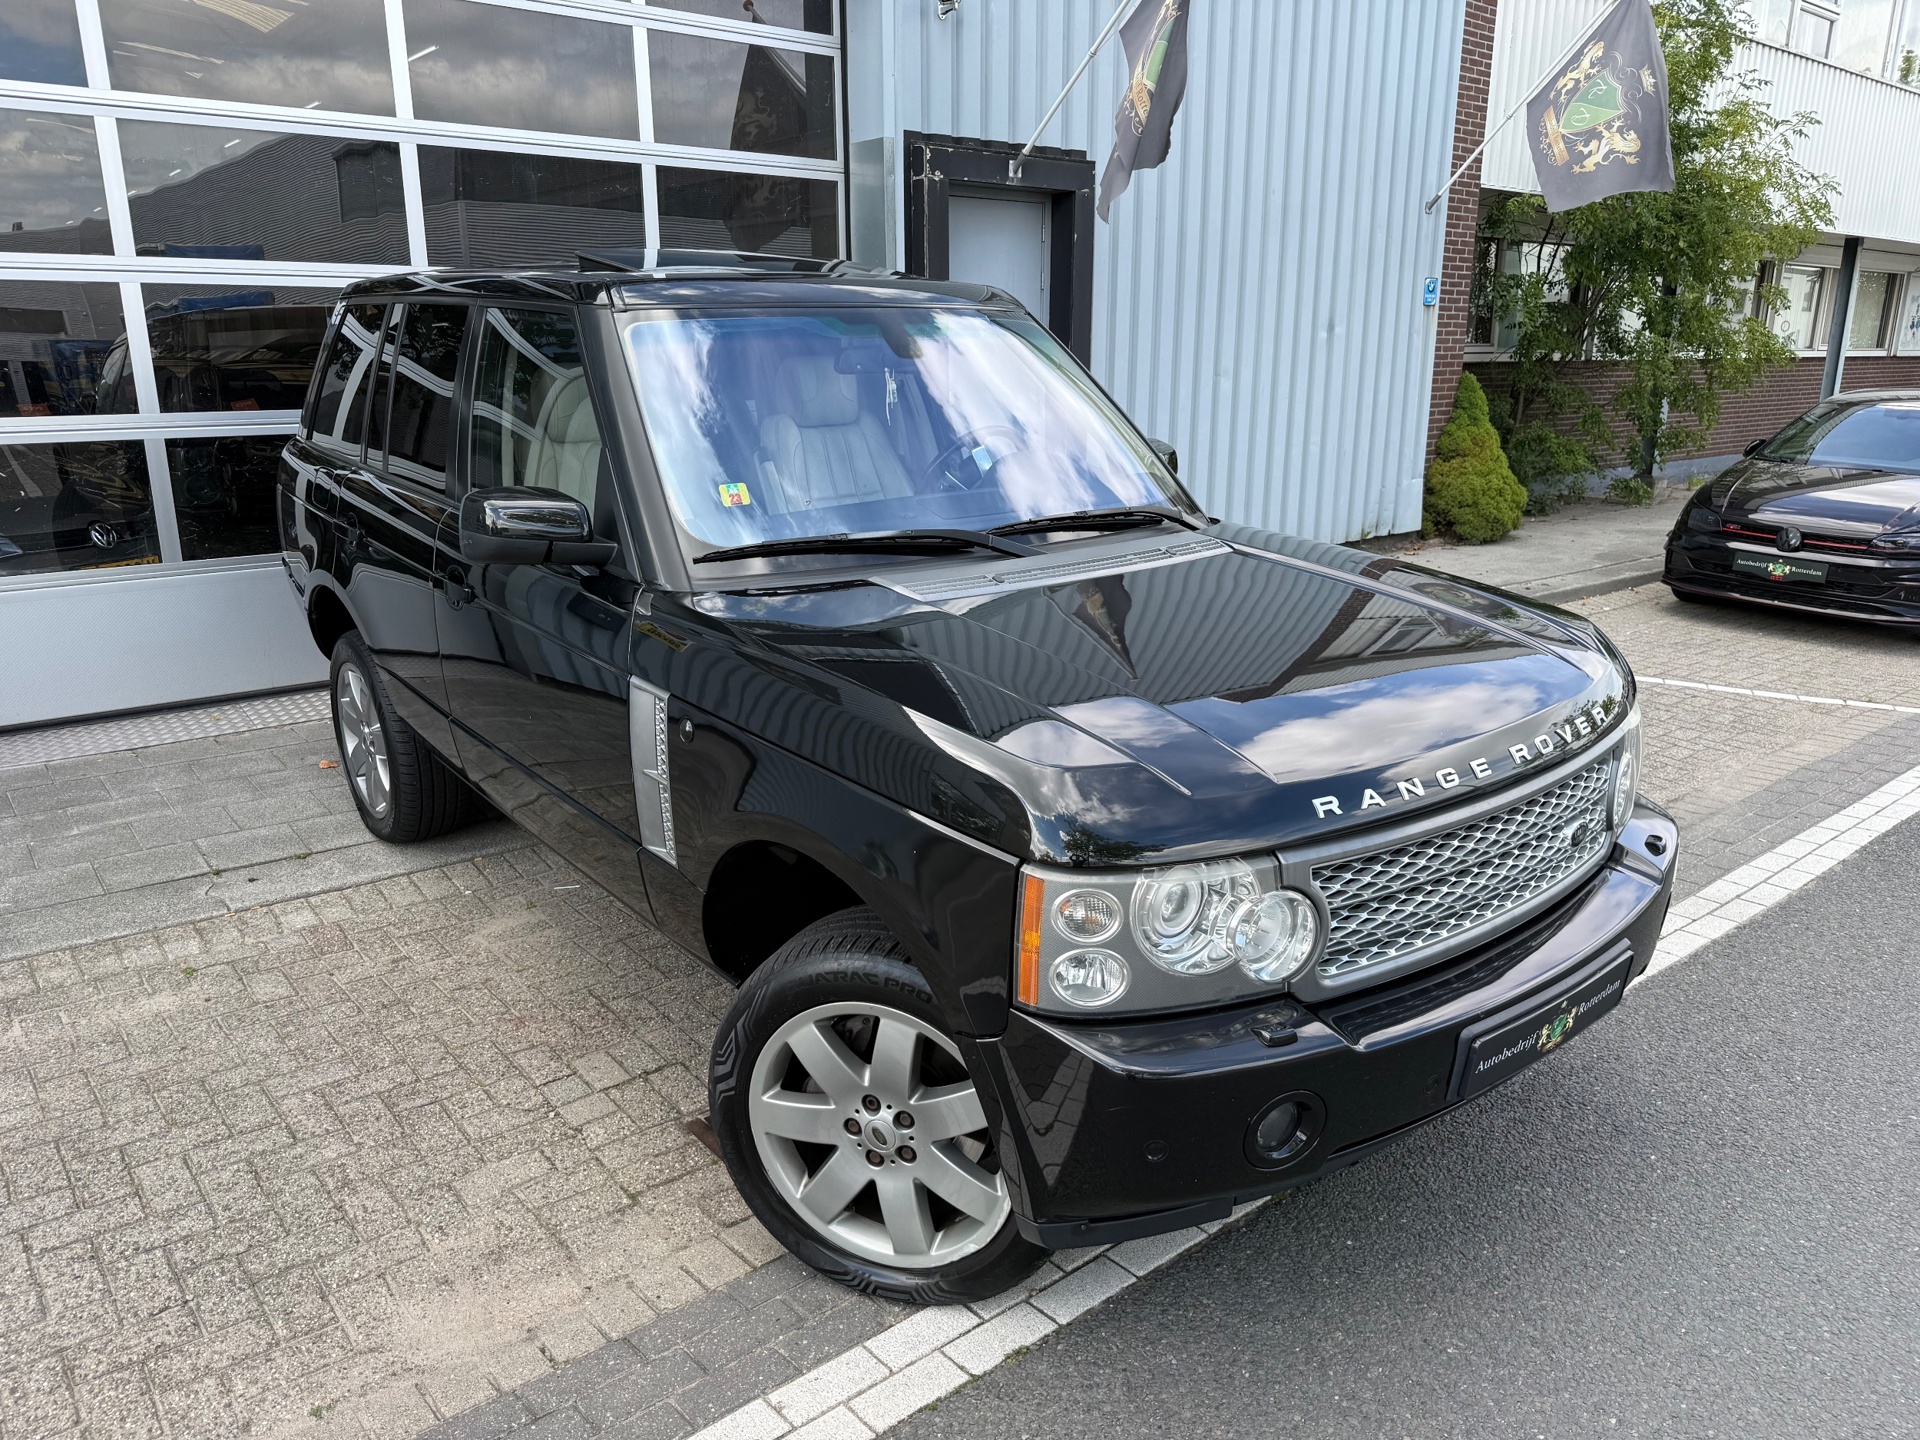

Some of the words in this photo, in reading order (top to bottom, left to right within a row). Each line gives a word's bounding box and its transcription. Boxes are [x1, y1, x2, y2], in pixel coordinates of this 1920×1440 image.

[1136, 88, 1148, 115] Rotte
[728, 494, 742, 504] 23
[1736, 558, 1768, 568] Autobedrijf
[1791, 566, 1822, 576] Rotterdam
[1311, 757, 1492, 819] RANGE
[1508, 706, 1608, 763] ROVER
[884, 976, 934, 1005] PRO
[1475, 1030, 1541, 1074] Autobedrijf
[1577, 979, 1621, 1016] Rotterdam
